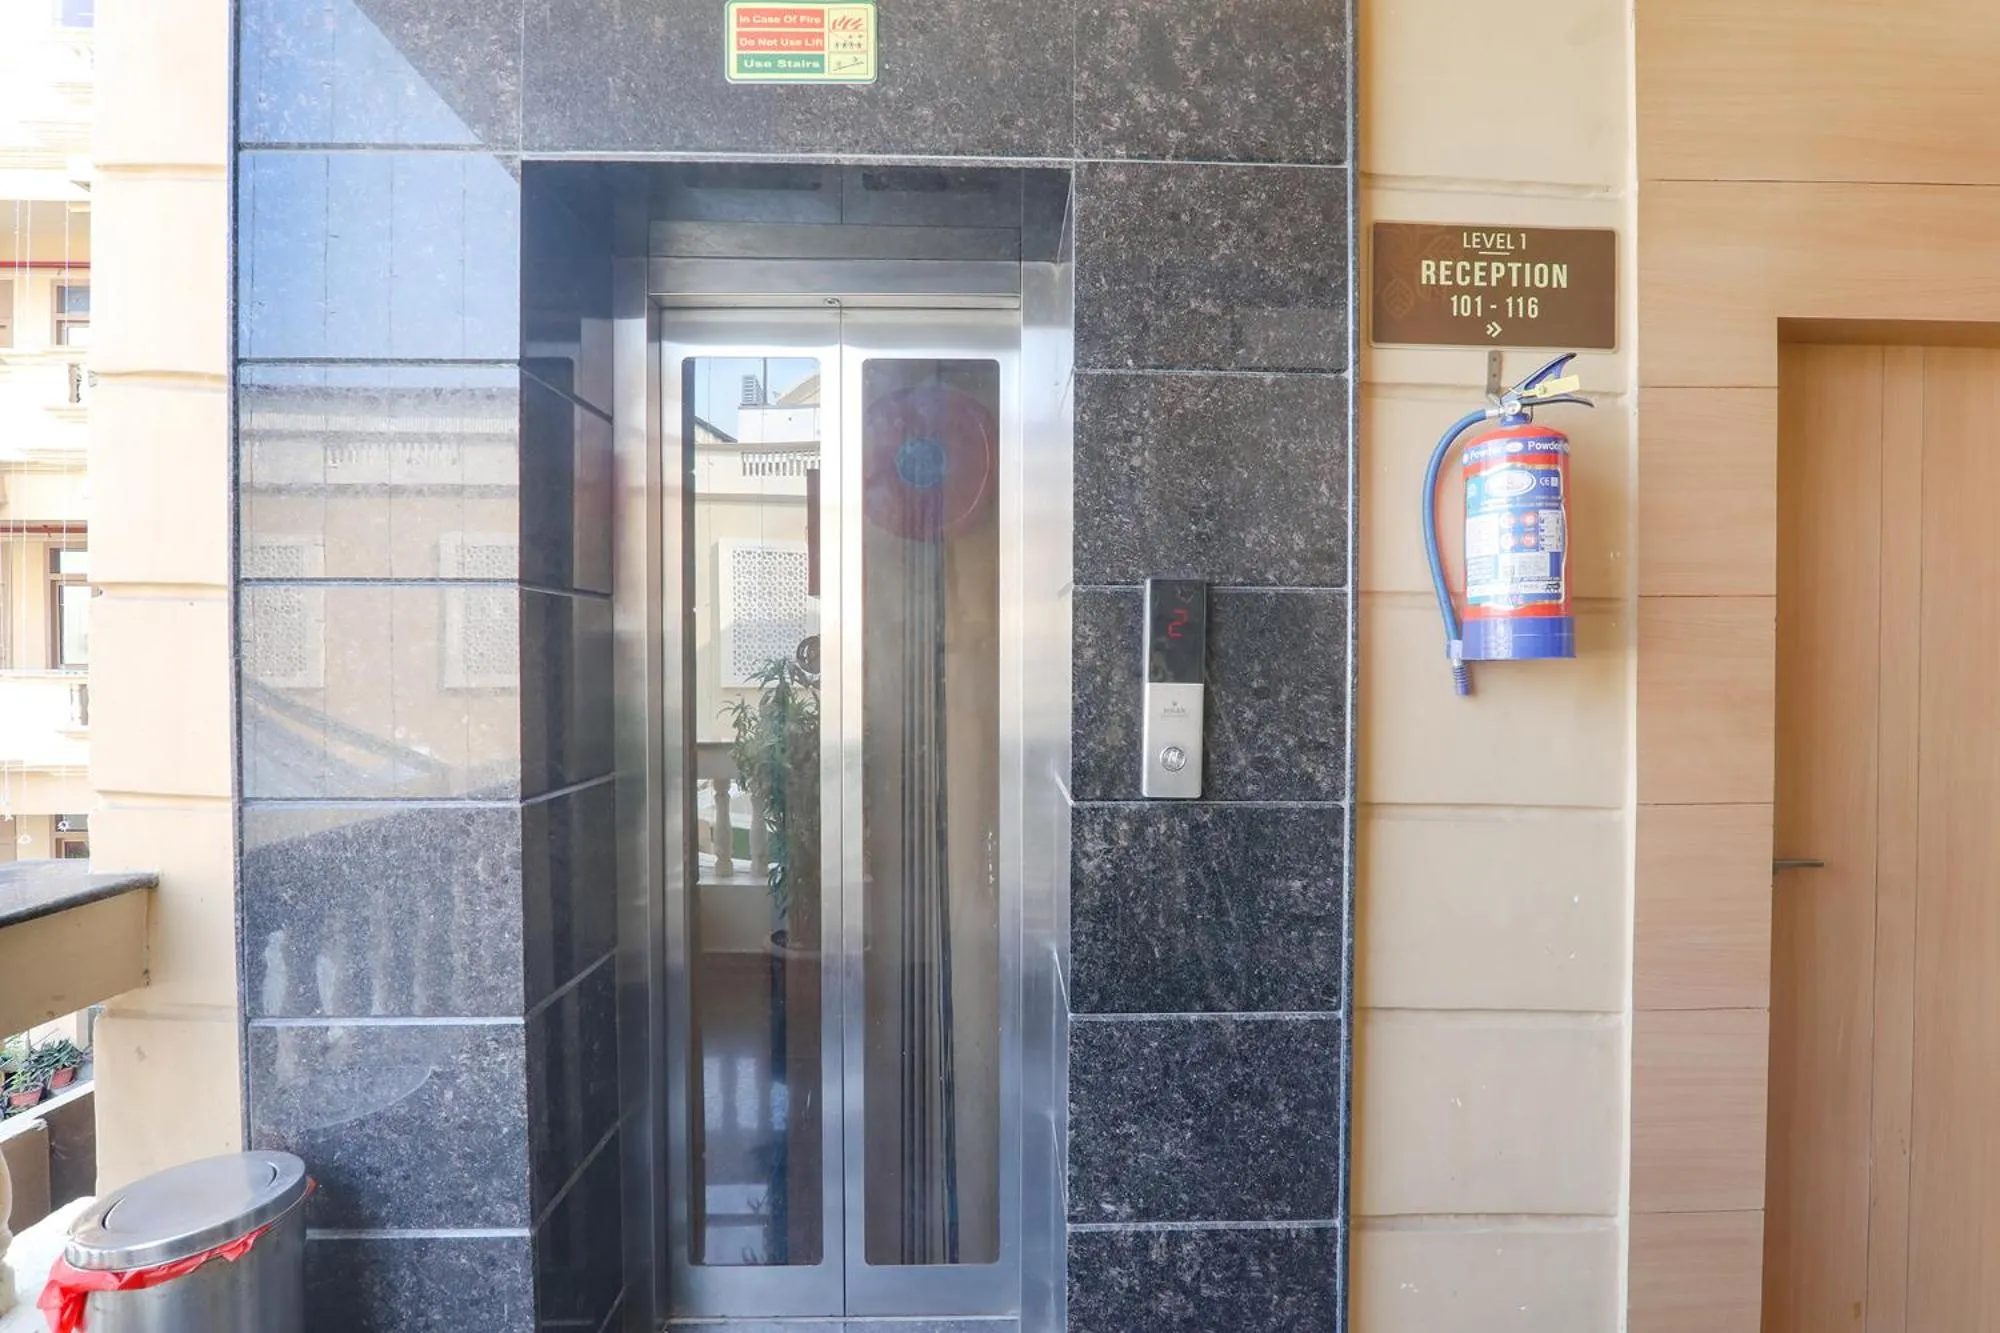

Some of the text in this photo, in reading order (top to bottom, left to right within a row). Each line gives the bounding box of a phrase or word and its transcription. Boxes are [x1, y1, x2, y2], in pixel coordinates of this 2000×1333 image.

[740, 15, 822, 24] In Case Of Fire
[740, 37, 823, 48] Do Not Use Lift
[744, 59, 820, 68] Use Stairs
[1463, 232, 1527, 250] LEVEL 1
[1420, 259, 1568, 288] RECEPTION
[1450, 294, 1482, 317] 101
[1506, 296, 1539, 318] 116
[1167, 607, 1188, 639] 2
